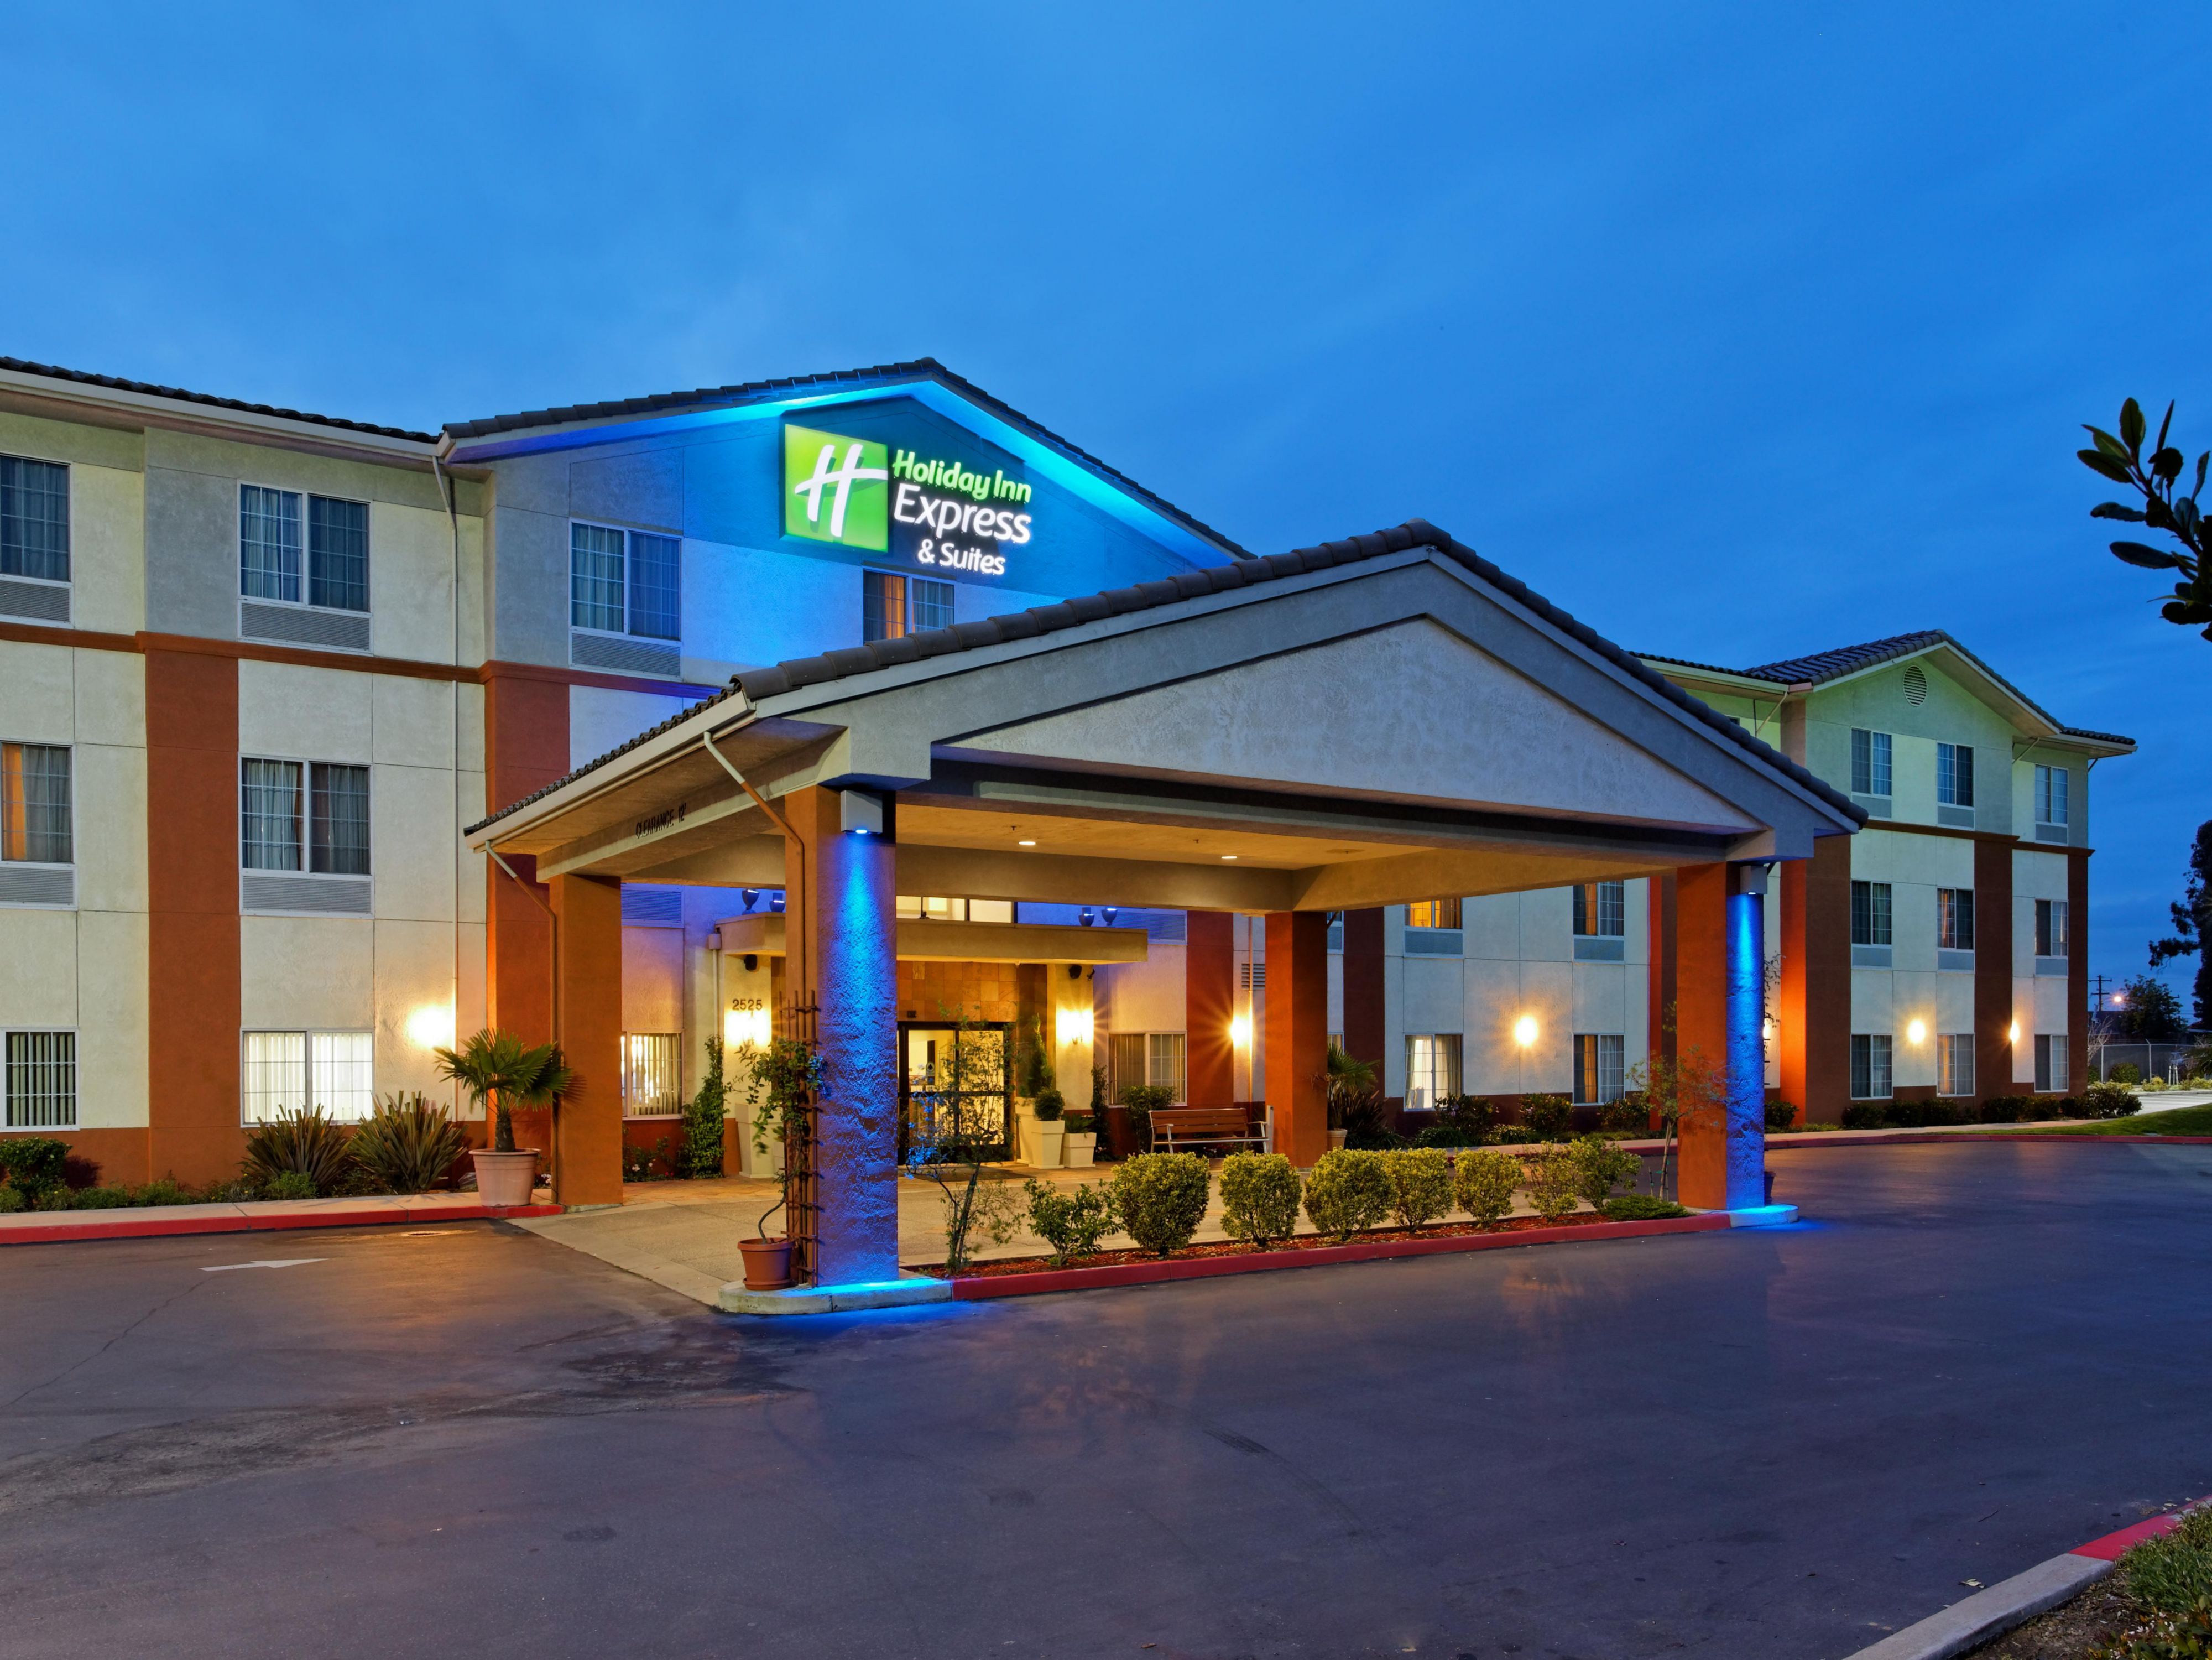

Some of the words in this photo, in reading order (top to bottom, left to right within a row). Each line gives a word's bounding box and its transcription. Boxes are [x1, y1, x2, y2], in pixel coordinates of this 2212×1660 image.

[893, 449, 990, 501] Holiday
[994, 470, 1032, 503] Inn
[894, 483, 1031, 544] Express
[918, 539, 935, 563] &
[939, 543, 1006, 575] Suites
[635, 809, 674, 839] CLEARANCE
[732, 999, 763, 1011] 2525
